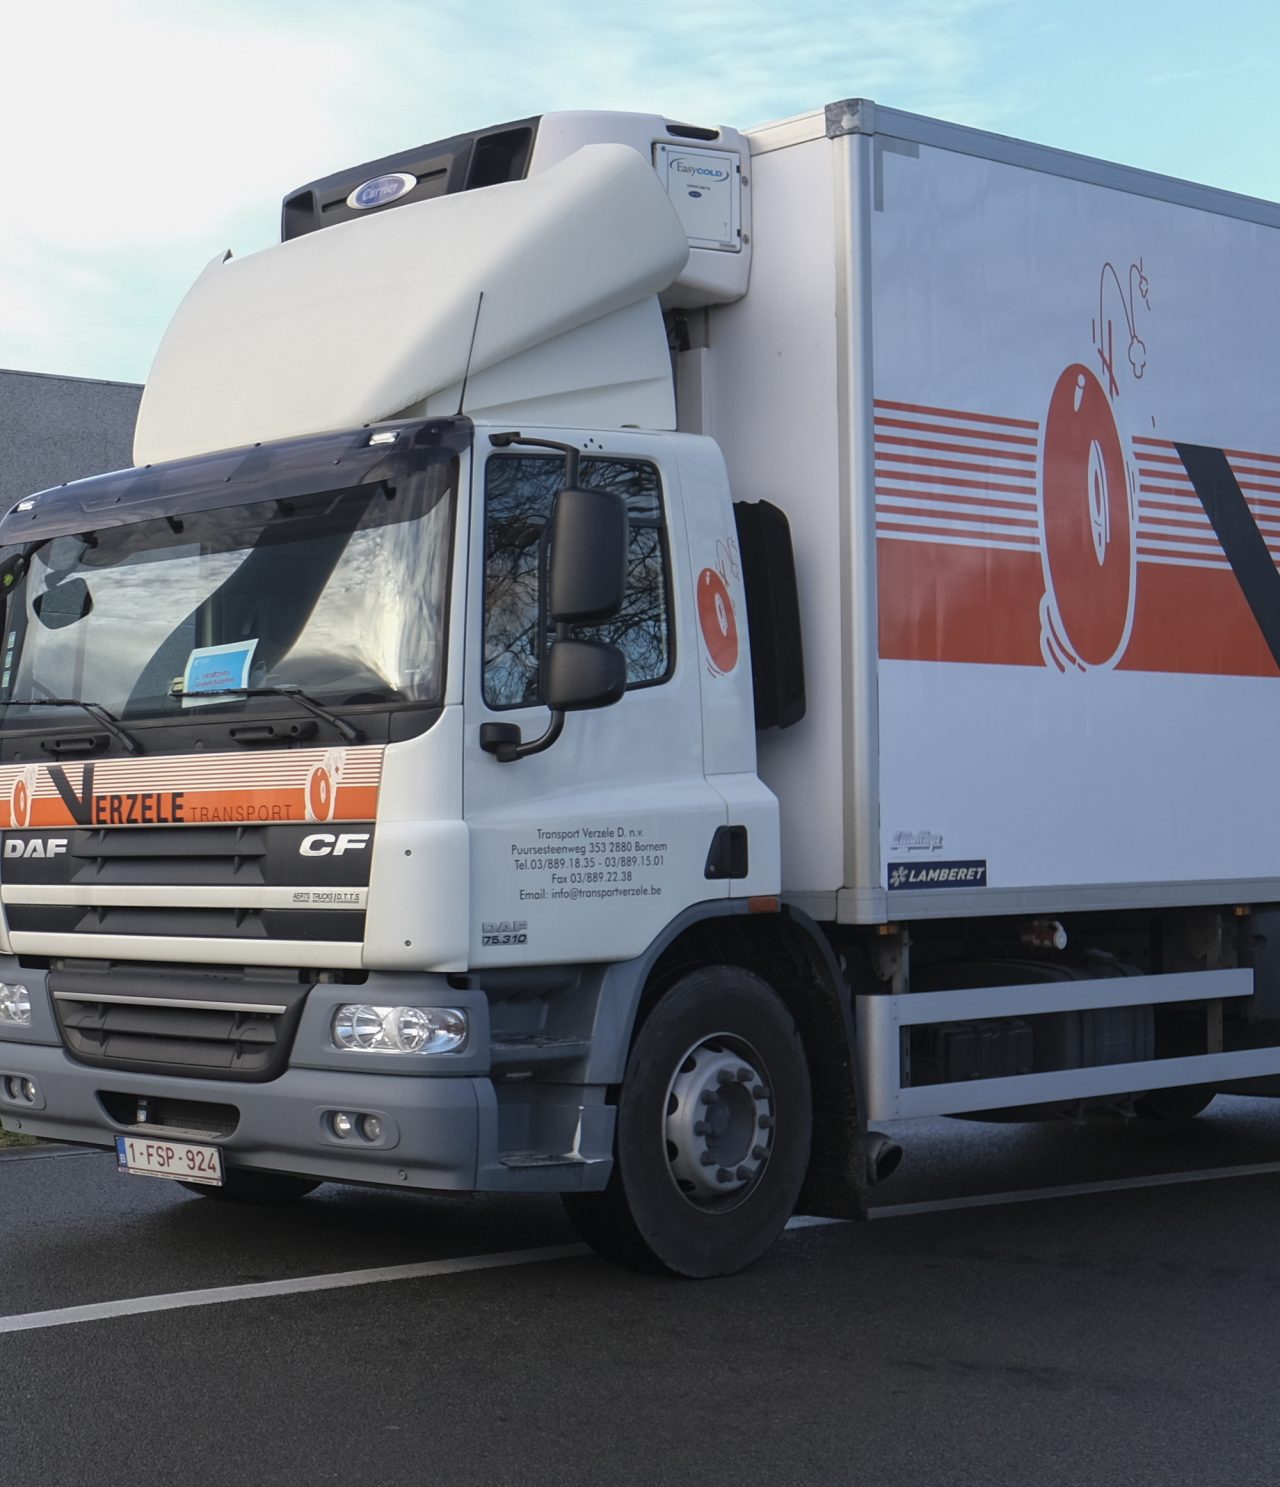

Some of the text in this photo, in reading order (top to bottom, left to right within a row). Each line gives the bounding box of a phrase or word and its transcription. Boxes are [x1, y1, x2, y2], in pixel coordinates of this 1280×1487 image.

[677, 161, 723, 177] EasyCOLD
[46, 763, 293, 826] VERZELE TRANSPORT
[537, 827, 644, 842] Transport Verzele D. n.v.
[3, 838, 68, 858] DAF
[299, 833, 370, 857] CF
[511, 841, 668, 856] Puursesteenweg 353 2880 Bornem
[605, 855, 664, 868] 03/889.15.01
[552, 871, 632, 884] Fax 03/889.22.38
[908, 867, 985, 883] LAMBERET
[519, 885, 662, 900] Email: info@transportverzele.be
[483, 934, 528, 945] 75.310
